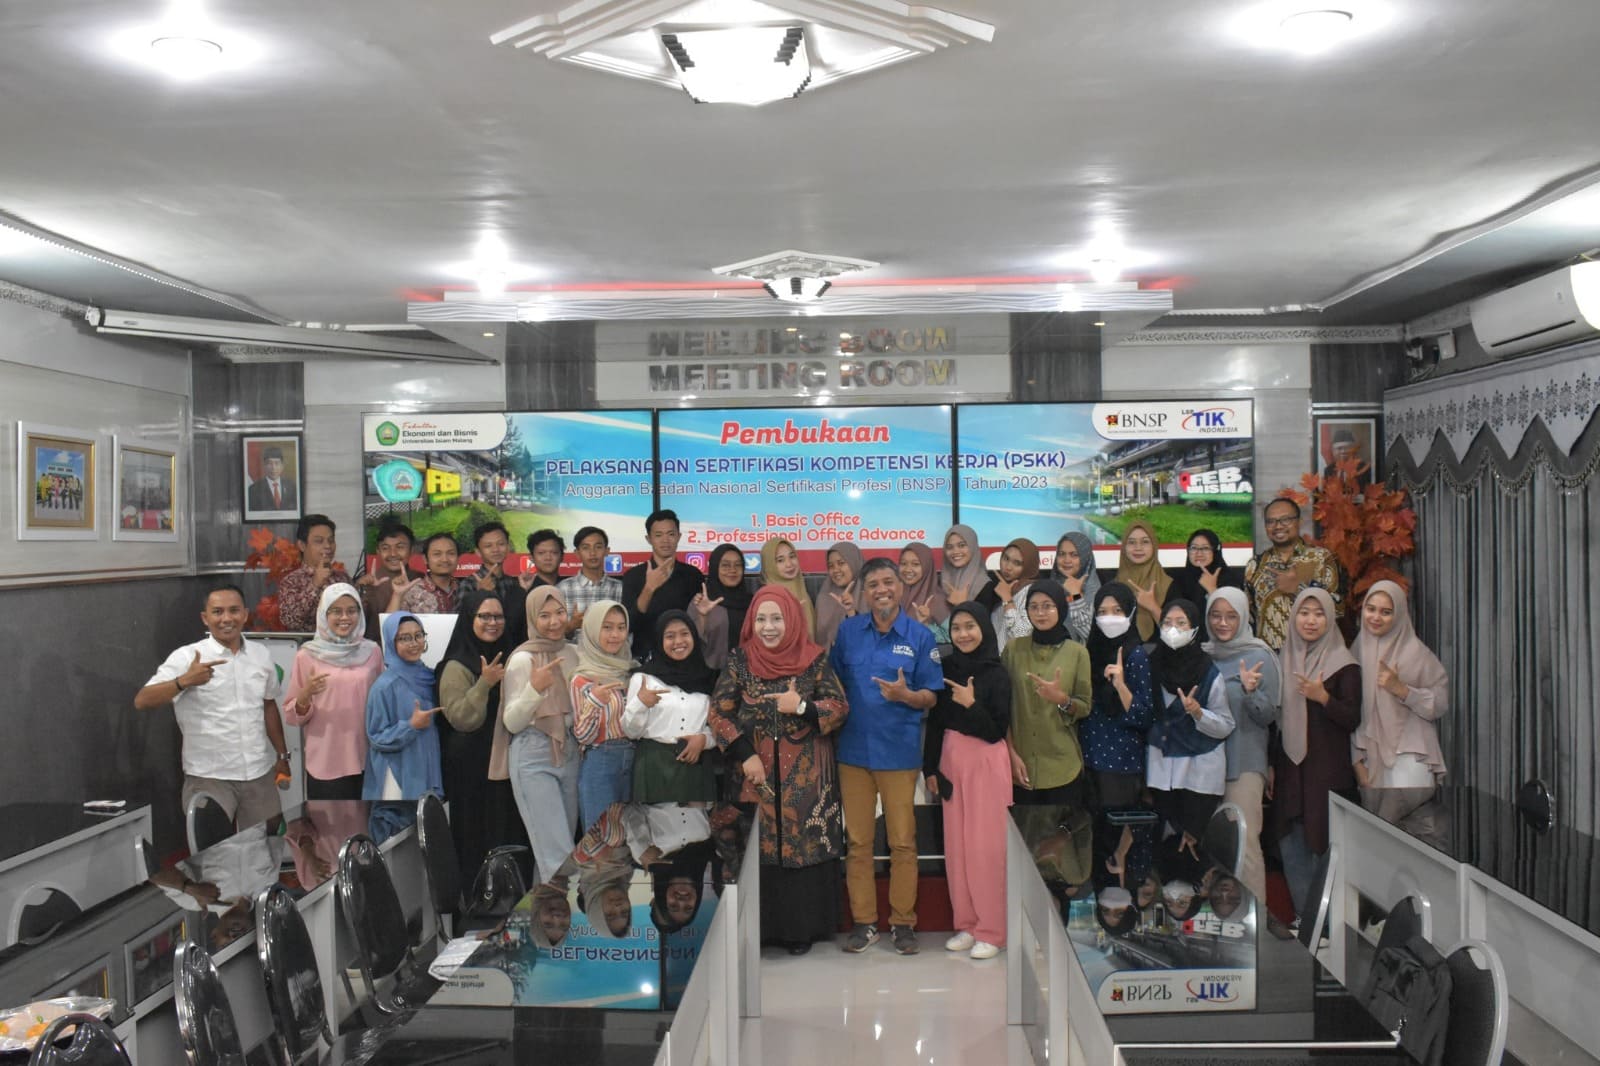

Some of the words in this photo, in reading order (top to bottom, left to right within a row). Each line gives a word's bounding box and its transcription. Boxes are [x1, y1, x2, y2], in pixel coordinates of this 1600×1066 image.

[649, 361, 827, 391] MEETING
[839, 359, 957, 388] ROOM
[1122, 413, 1167, 428] BNSP
[1192, 412, 1225, 426] TIK
[720, 419, 890, 445] Pembukaan
[695, 458, 804, 474] SERTIFIKASI
[810, 455, 929, 473] KOMPETENSI
[935, 454, 998, 471] KERJA
[1004, 451, 1066, 470] (PSKK)
[1190, 467, 1242, 486] FEB
[565, 483, 635, 498] Anggaran
[699, 481, 764, 495] Nasional
[766, 480, 837, 493] Sertifikasi
[841, 479, 891, 492] Profesi
[896, 477, 952, 493] (BNSP)
[963, 476, 1007, 490] Tahun
[1012, 475, 1048, 489] 2023
[751, 514, 761, 527] 1.
[766, 513, 808, 527] Basic
[813, 512, 861, 527] Office
[687, 530, 701, 543] 2.
[706, 529, 801, 543] Professional
[807, 528, 854, 542] Office
[859, 527, 925, 541] Advance
